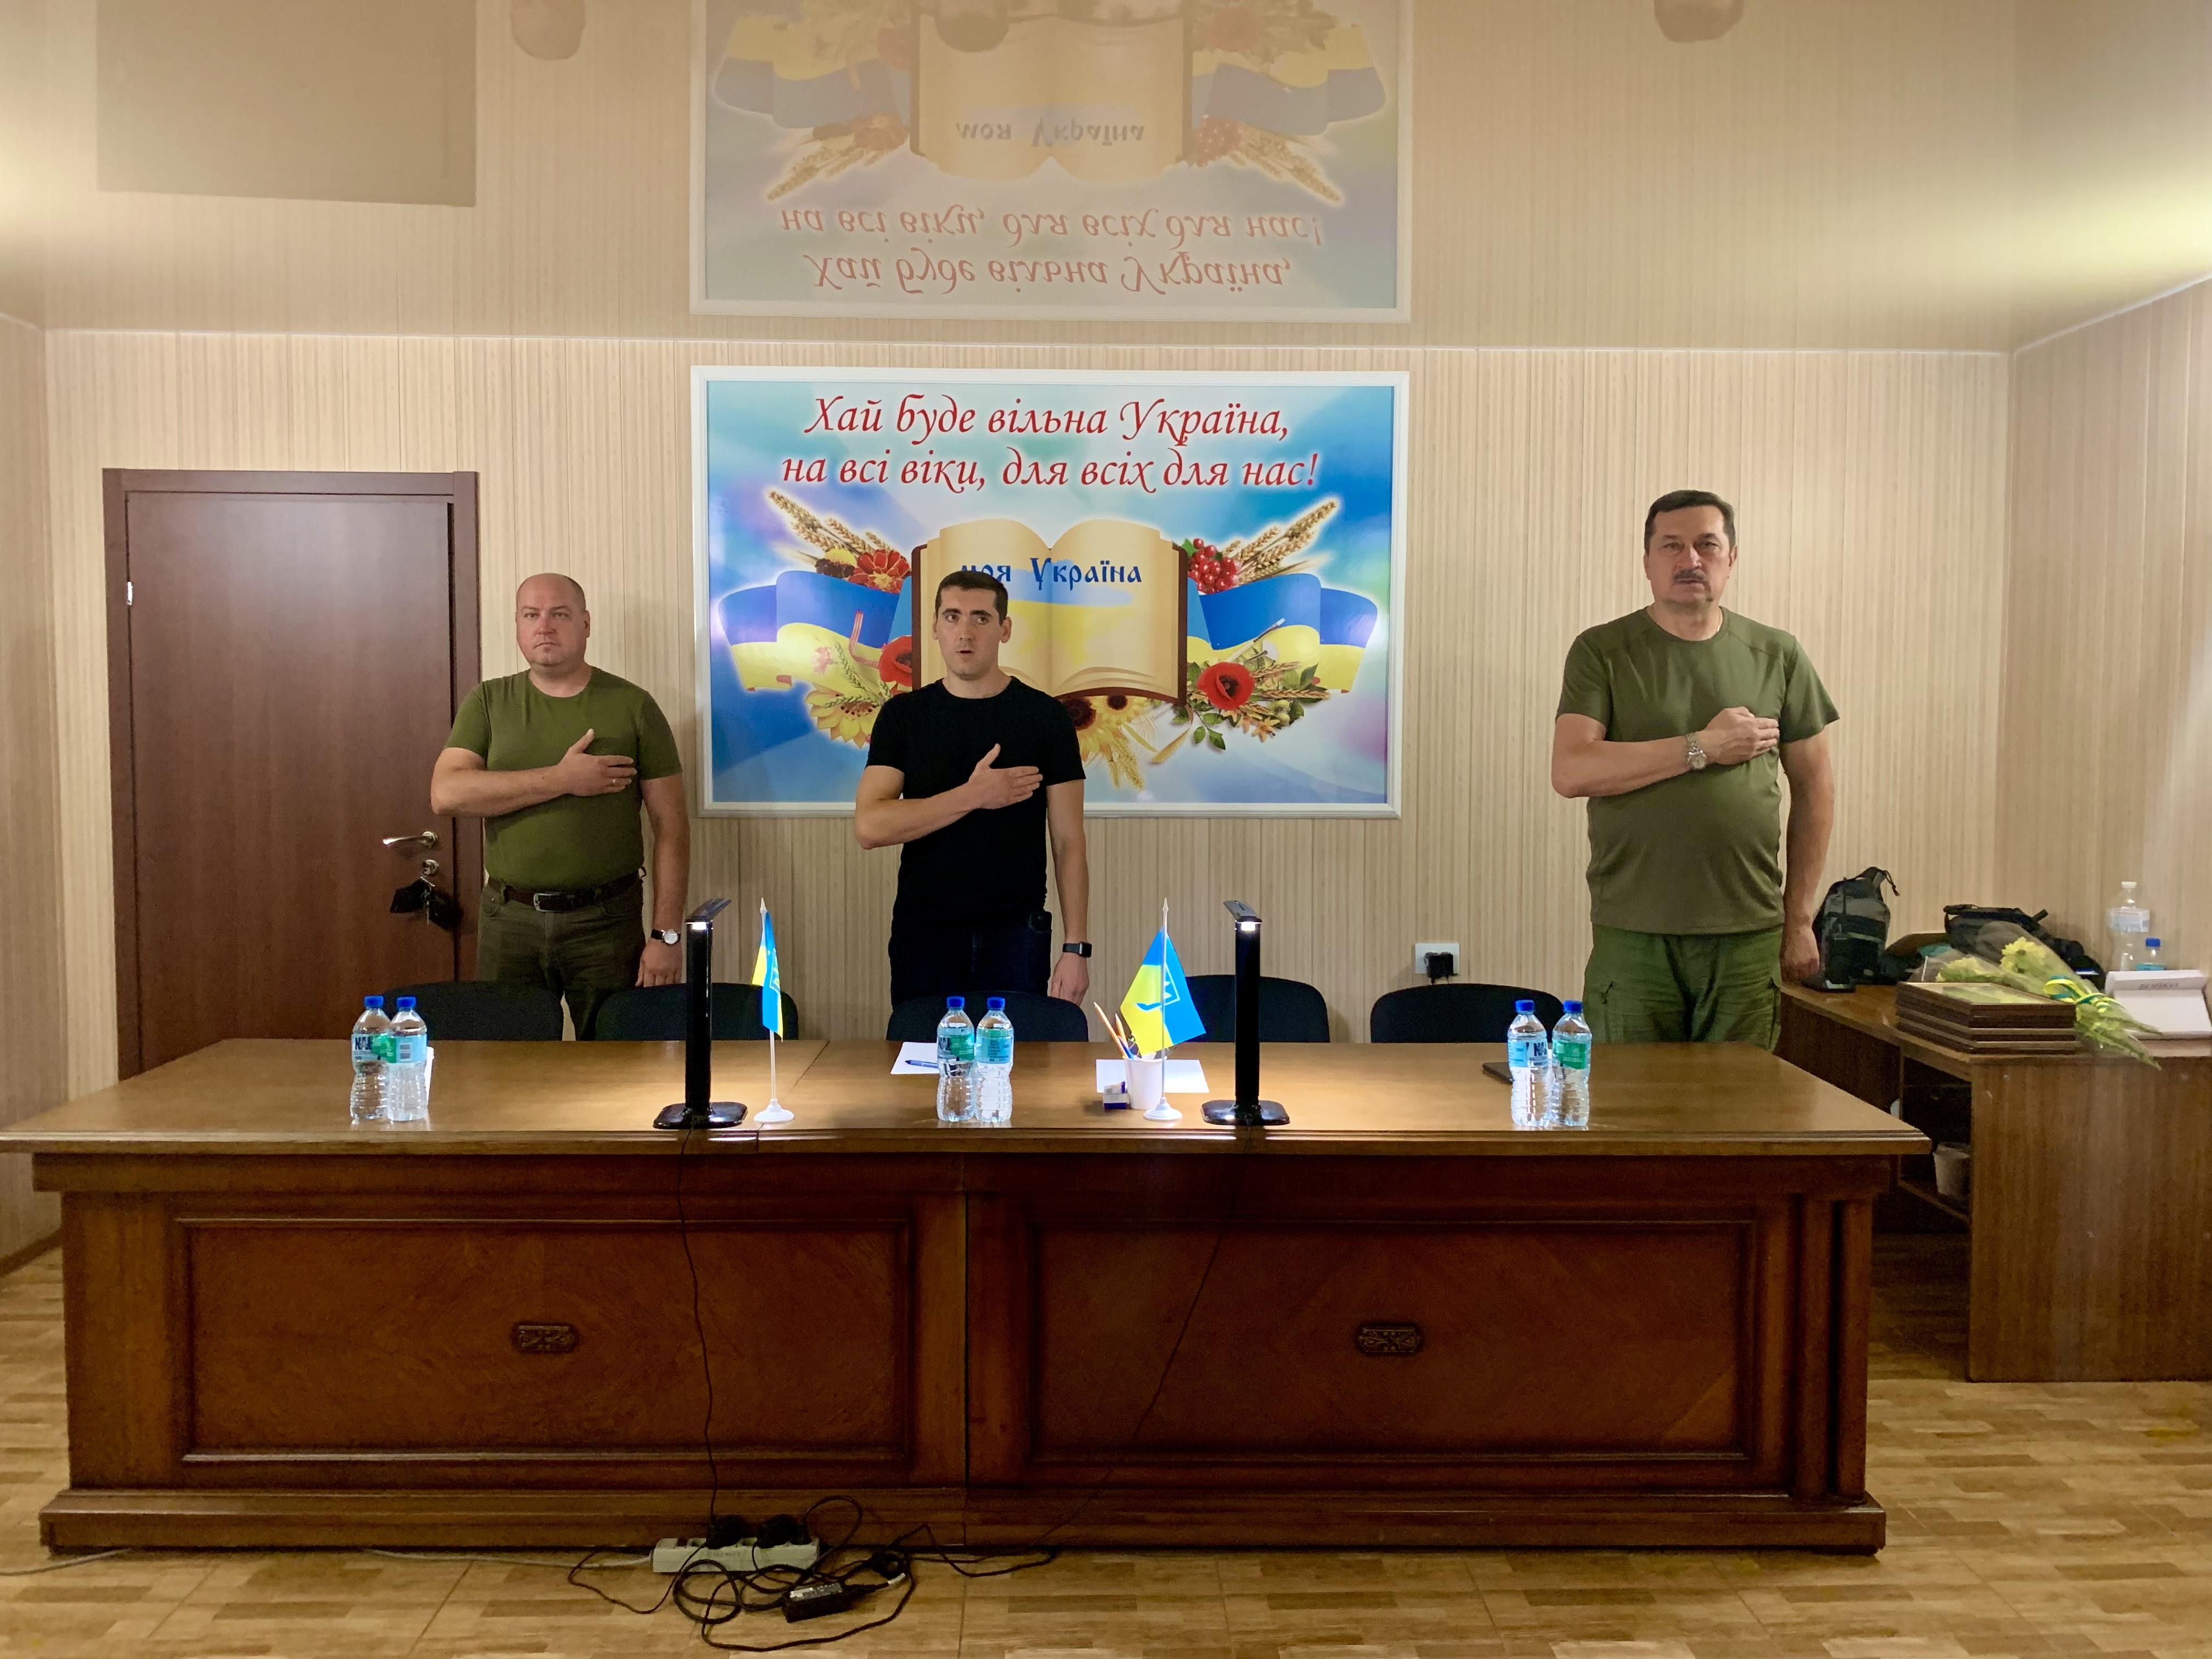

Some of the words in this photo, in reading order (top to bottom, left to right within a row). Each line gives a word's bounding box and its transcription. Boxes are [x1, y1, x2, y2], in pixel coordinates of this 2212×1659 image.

[803, 395, 883, 433] Хай
[896, 393, 976, 445] буде
[988, 398, 1109, 433] вільна
[1119, 399, 1289, 447] Україна,
[782, 459, 827, 483] на
[839, 449, 890, 483] всі
[900, 450, 986, 493] віки,
[1002, 447, 1068, 485] для
[1081, 450, 1156, 493] всіх
[1163, 448, 1229, 486] для
[1242, 452, 1319, 486] нас!
[1029, 557, 1142, 591] Україна
